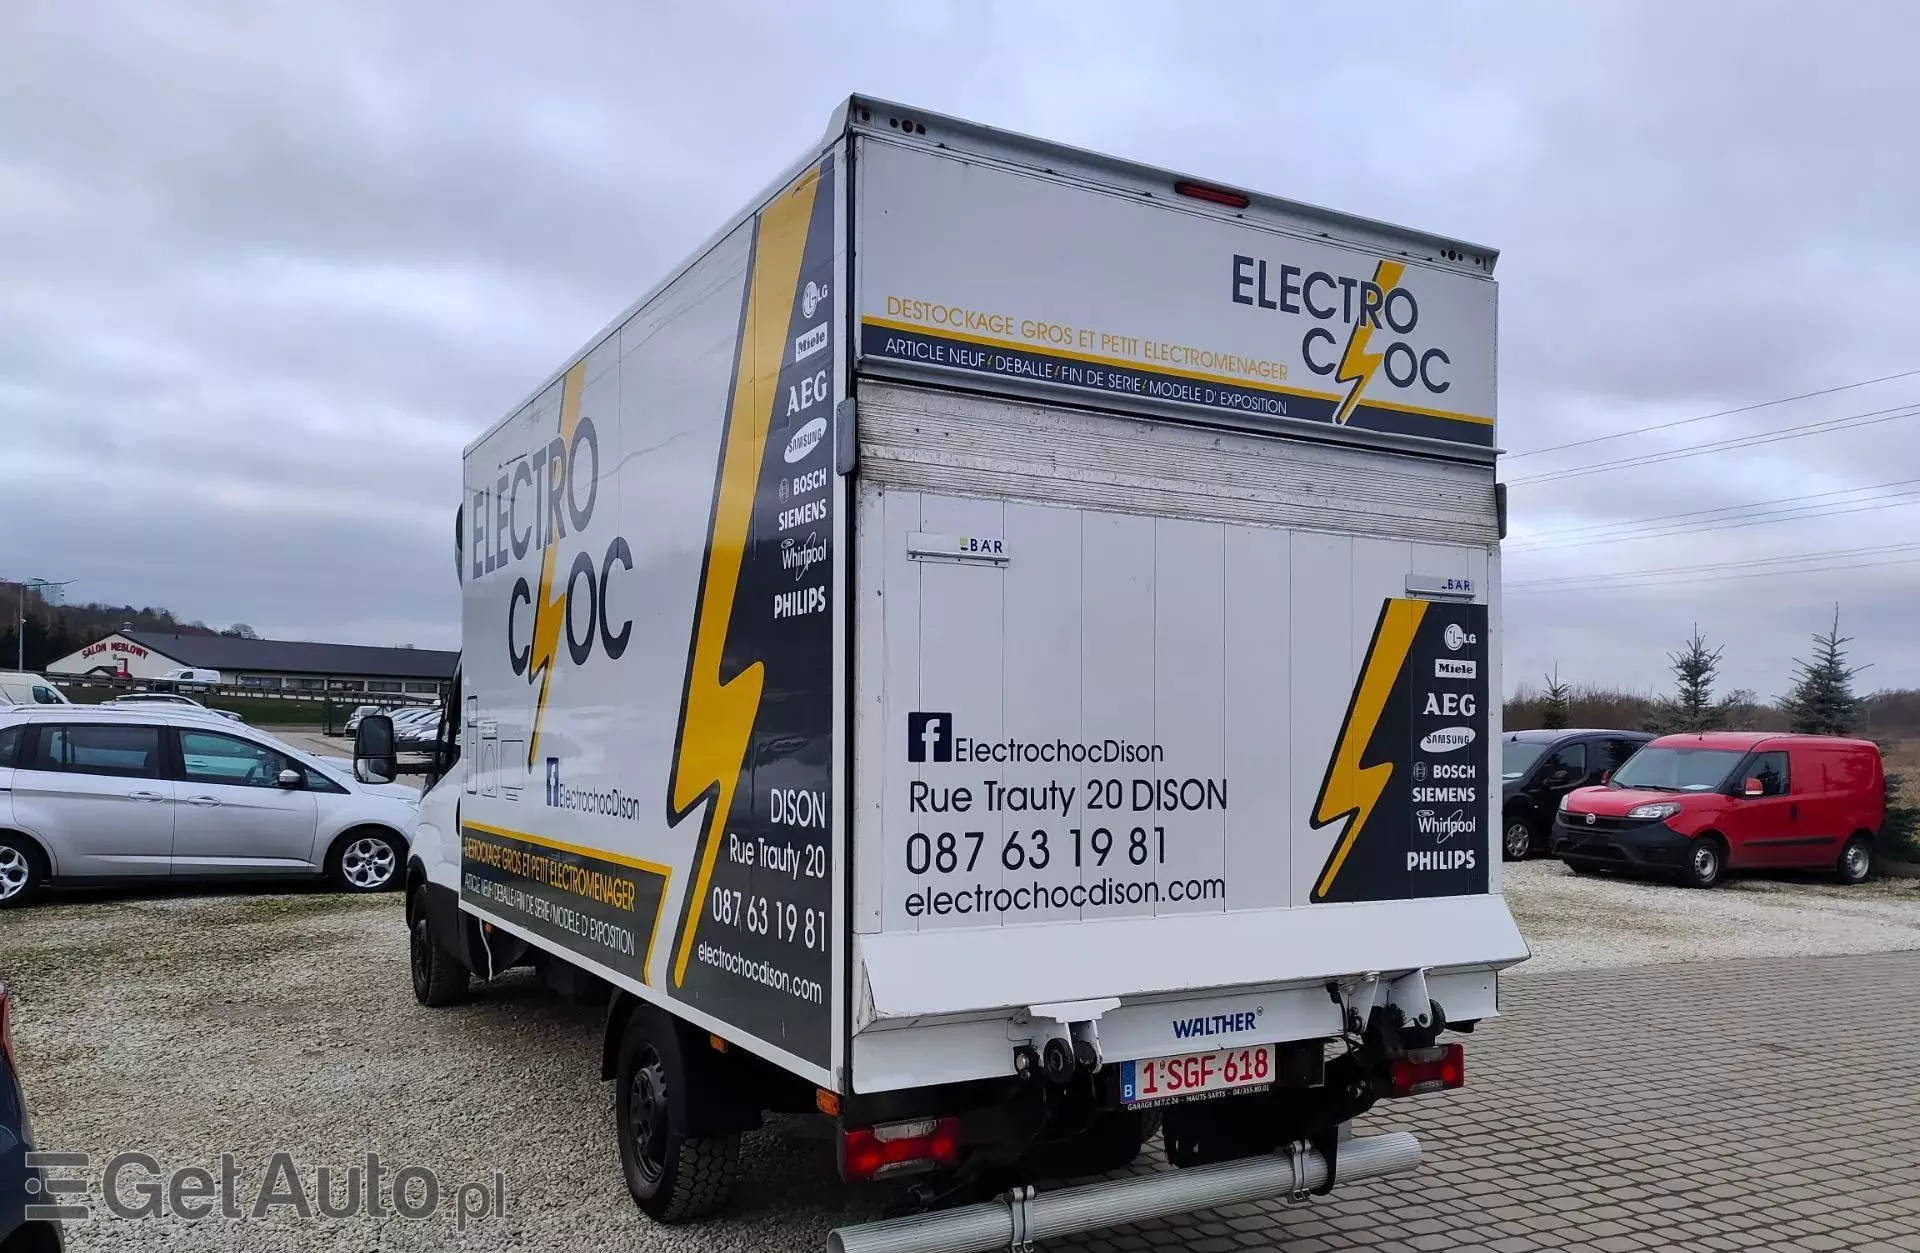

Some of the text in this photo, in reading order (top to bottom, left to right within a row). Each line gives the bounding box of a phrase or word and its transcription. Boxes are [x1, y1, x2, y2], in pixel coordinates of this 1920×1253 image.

[1232, 254, 1418, 334] ELECTRO
[797, 330, 826, 355] Miele
[887, 295, 1289, 381] DESTOCKAGE GROS ET PETIT ELECTROMENAGER
[786, 369, 828, 417] AEG
[885, 337, 944, 361] ARTICLE
[1086, 369, 1105, 386] DE
[1149, 379, 1201, 402] MODELE
[1220, 391, 1288, 415] EXPOSITION
[788, 427, 823, 454] SAMSUNG
[472, 416, 599, 580] ELECTRO
[793, 467, 827, 496] BOSCH
[778, 498, 827, 532] SIEMENS
[781, 536, 827, 573] Whirlpool
[773, 585, 827, 620] PHILIPS
[82, 641, 107, 660] SALON
[1438, 663, 1474, 675] Miele
[1422, 692, 1477, 717] AEG
[955, 737, 1164, 764] ElectrochocDison
[1426, 734, 1471, 745] SAMSUNG
[1432, 764, 1476, 779] BOSCH
[559, 783, 640, 821] ElectrochocDison
[770, 788, 826, 829] DISON
[909, 778, 1227, 817] Rue Trauty 20 DISON
[1411, 787, 1476, 803] SIEMENS
[1418, 815, 1476, 839] Whirlpool
[729, 833, 825, 881] Rue Trauty 20
[906, 826, 1165, 875] 087 63 19 81
[1406, 849, 1476, 871] PHILIPS
[502, 846, 522, 875] GROS
[550, 860, 636, 913] ELECTROMENAGER
[905, 877, 1226, 917] electrochocdison.com
[590, 917, 636, 957] EXPOSITION
[712, 887, 825, 952] 087 63 19 81
[698, 941, 822, 1005] electrochocdison.com
[1124, 1084, 1133, 1098] B
[1127, 1100, 1153, 1111] GARAGE
